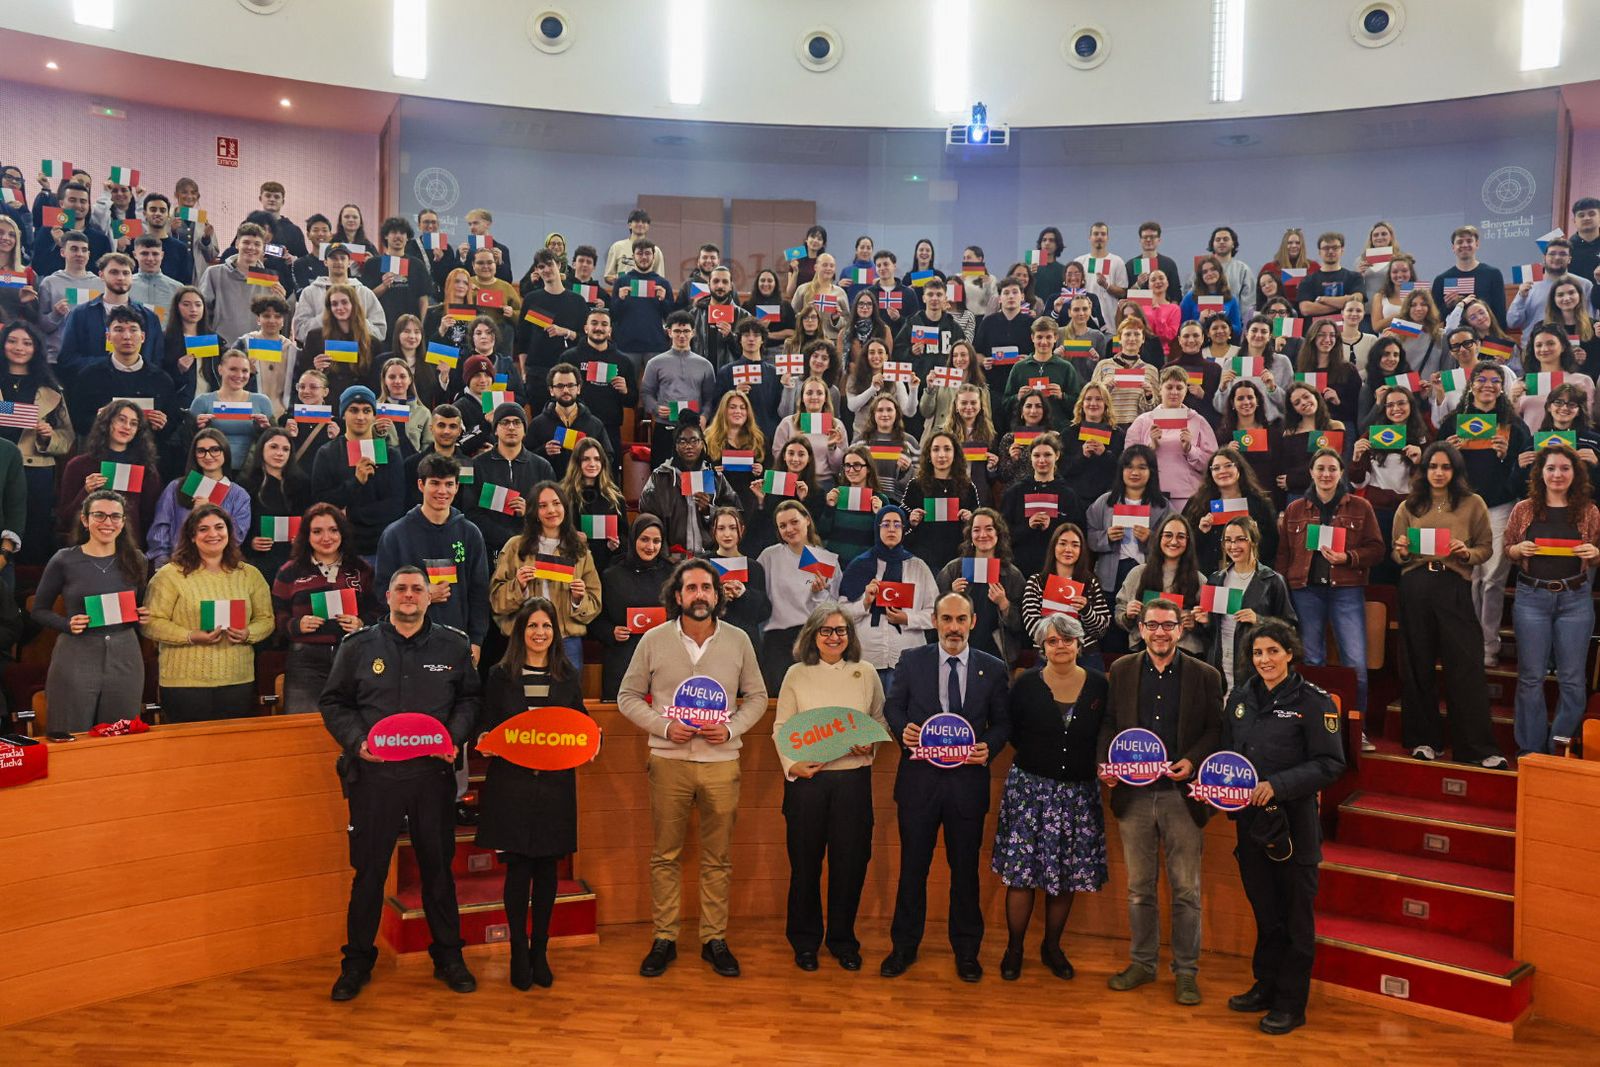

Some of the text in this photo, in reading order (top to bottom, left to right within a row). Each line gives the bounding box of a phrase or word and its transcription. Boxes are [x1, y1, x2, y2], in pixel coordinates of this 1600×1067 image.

[681, 685, 724, 702] HUELVA
[667, 706, 727, 721] ERASMUS
[504, 728, 588, 746] Welcome
[789, 718, 846, 749] Salut
[926, 725, 969, 737] HUELVA
[374, 733, 443, 747] Welcome
[1116, 740, 1160, 753] HUELVA
[1105, 762, 1168, 775] ERASMUS
[1206, 762, 1252, 780] HUELVA
[1195, 784, 1251, 799] ERASMU
